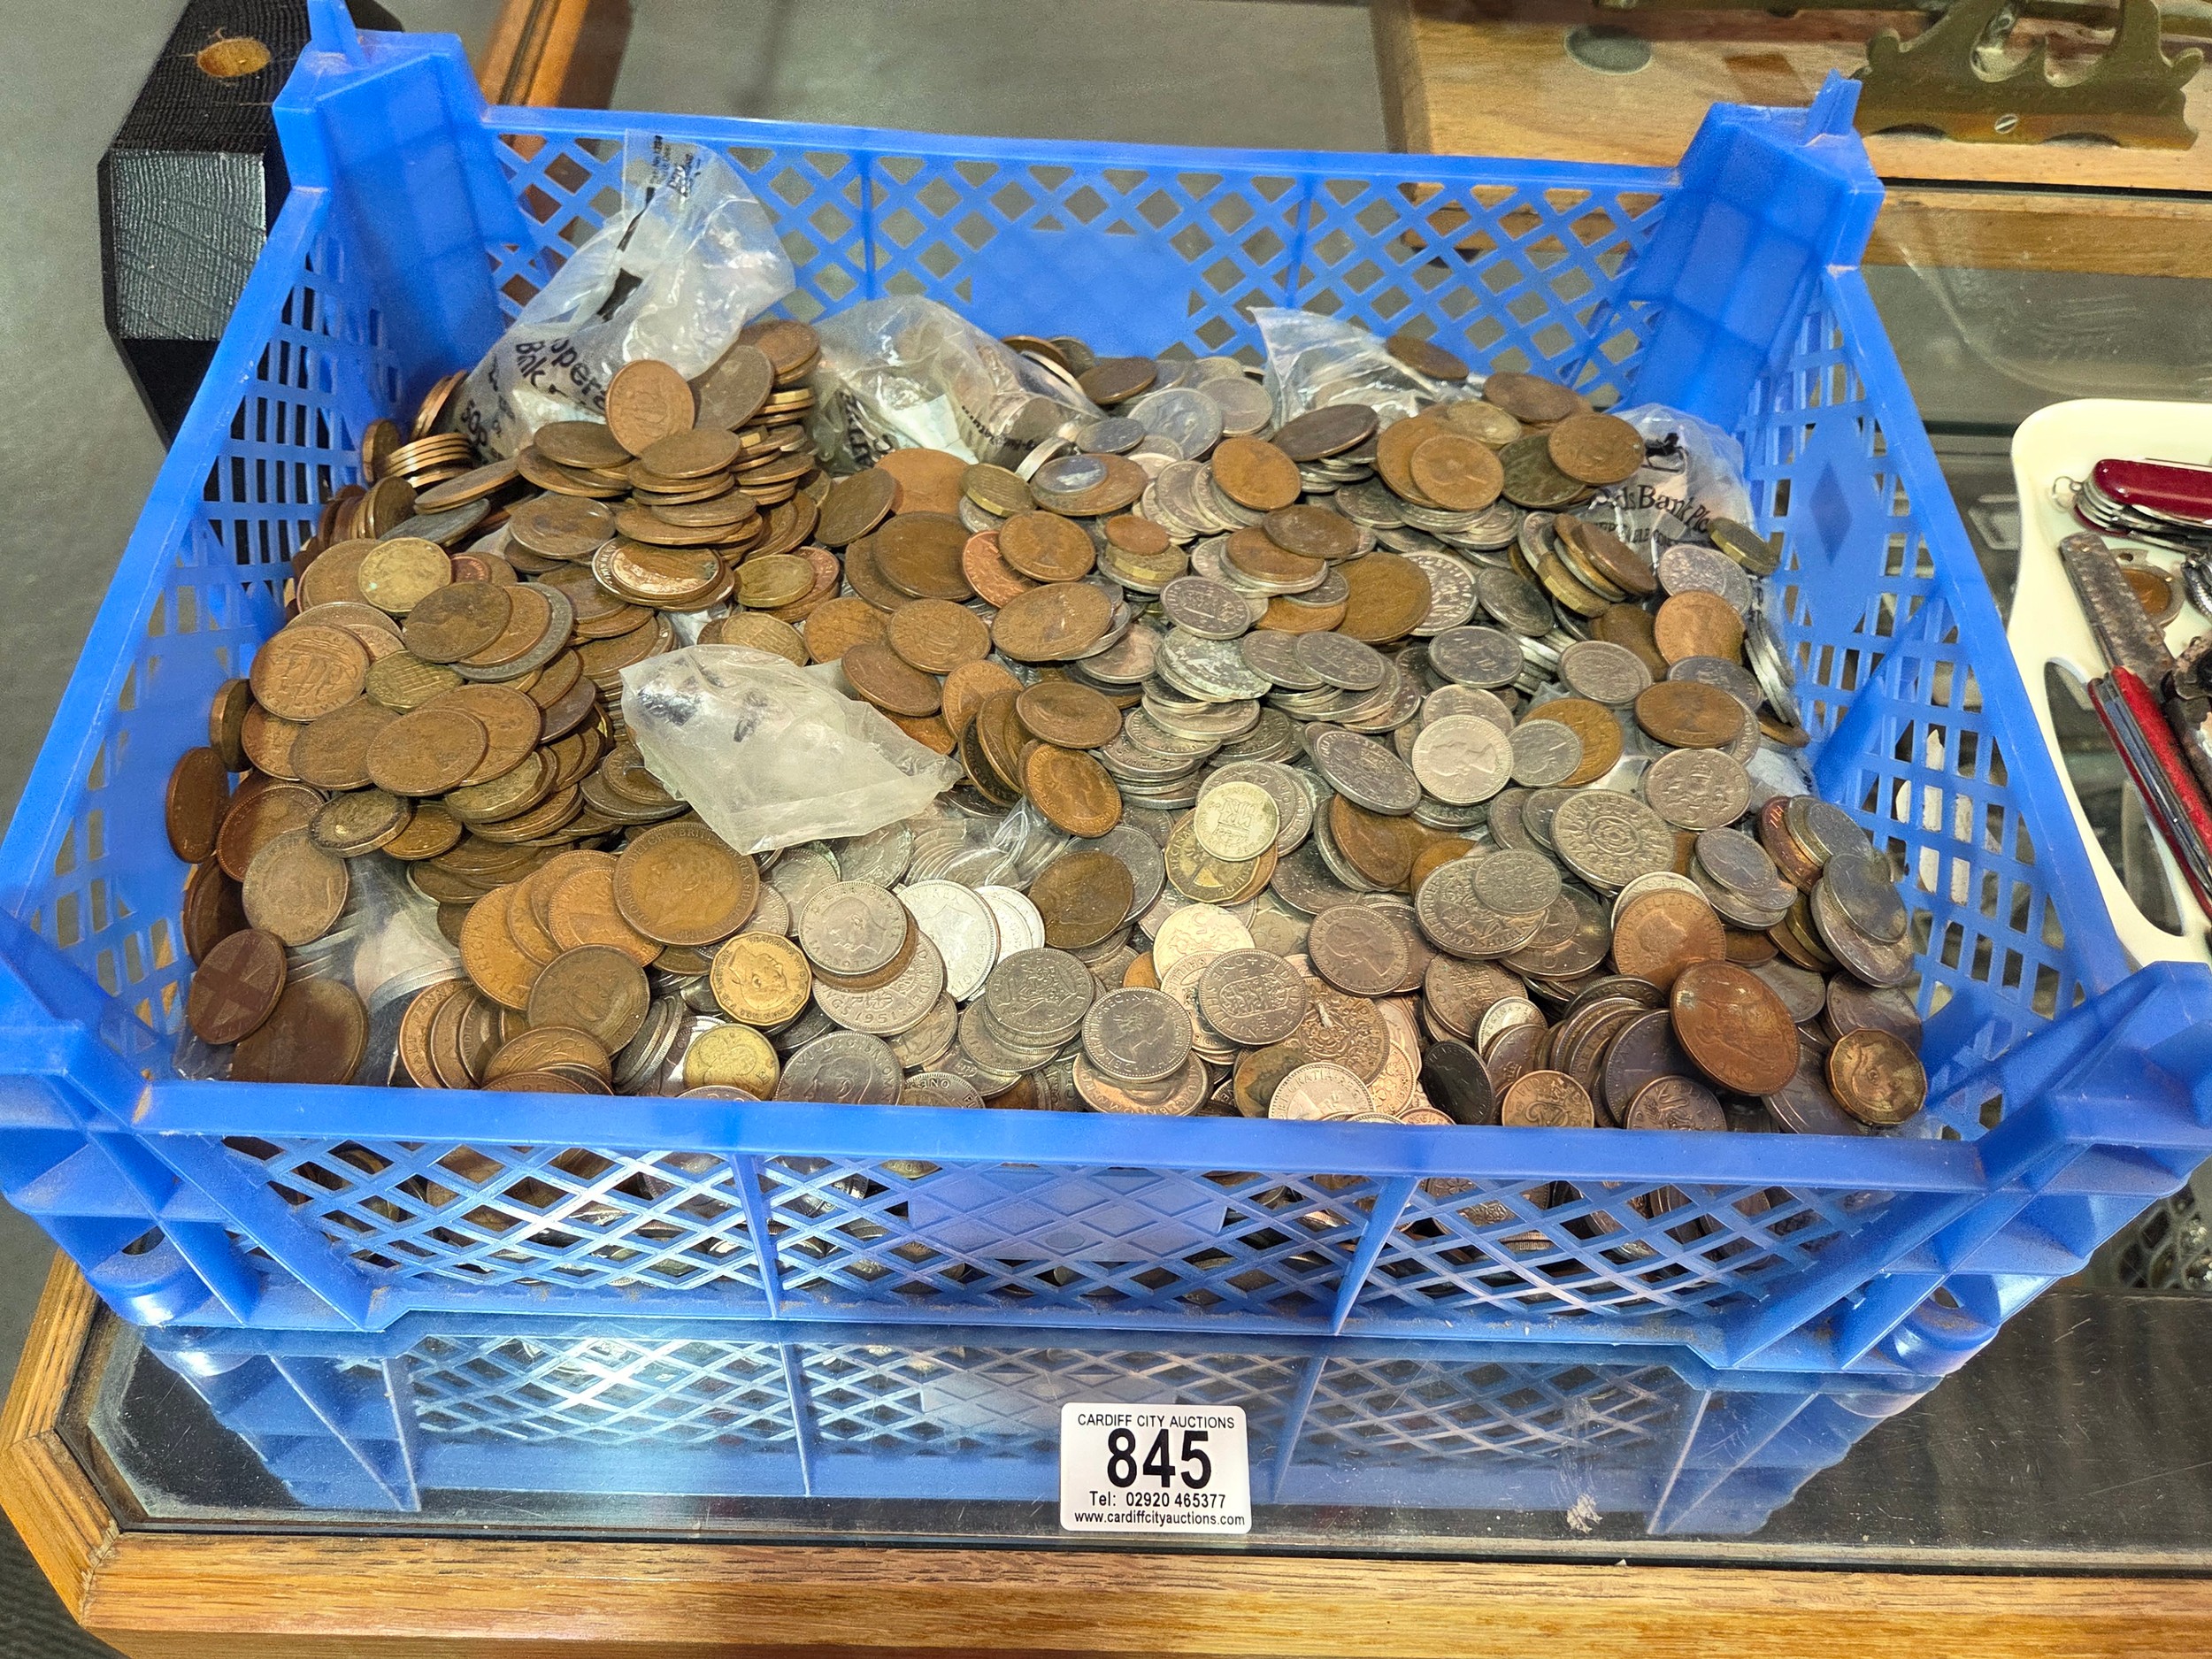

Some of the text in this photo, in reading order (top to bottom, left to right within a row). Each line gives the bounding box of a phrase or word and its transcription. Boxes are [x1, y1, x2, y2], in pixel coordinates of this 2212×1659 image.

[1637, 484, 1694, 524] Bank
[1078, 1414, 1235, 1429] CARDIFF CITY AUCTIONS
[1107, 1427, 1212, 1489] 845
[1089, 1490, 1226, 1509] Tel: 02920 465377
[1074, 1509, 1245, 1527] www.cardiffcityauctions.com
